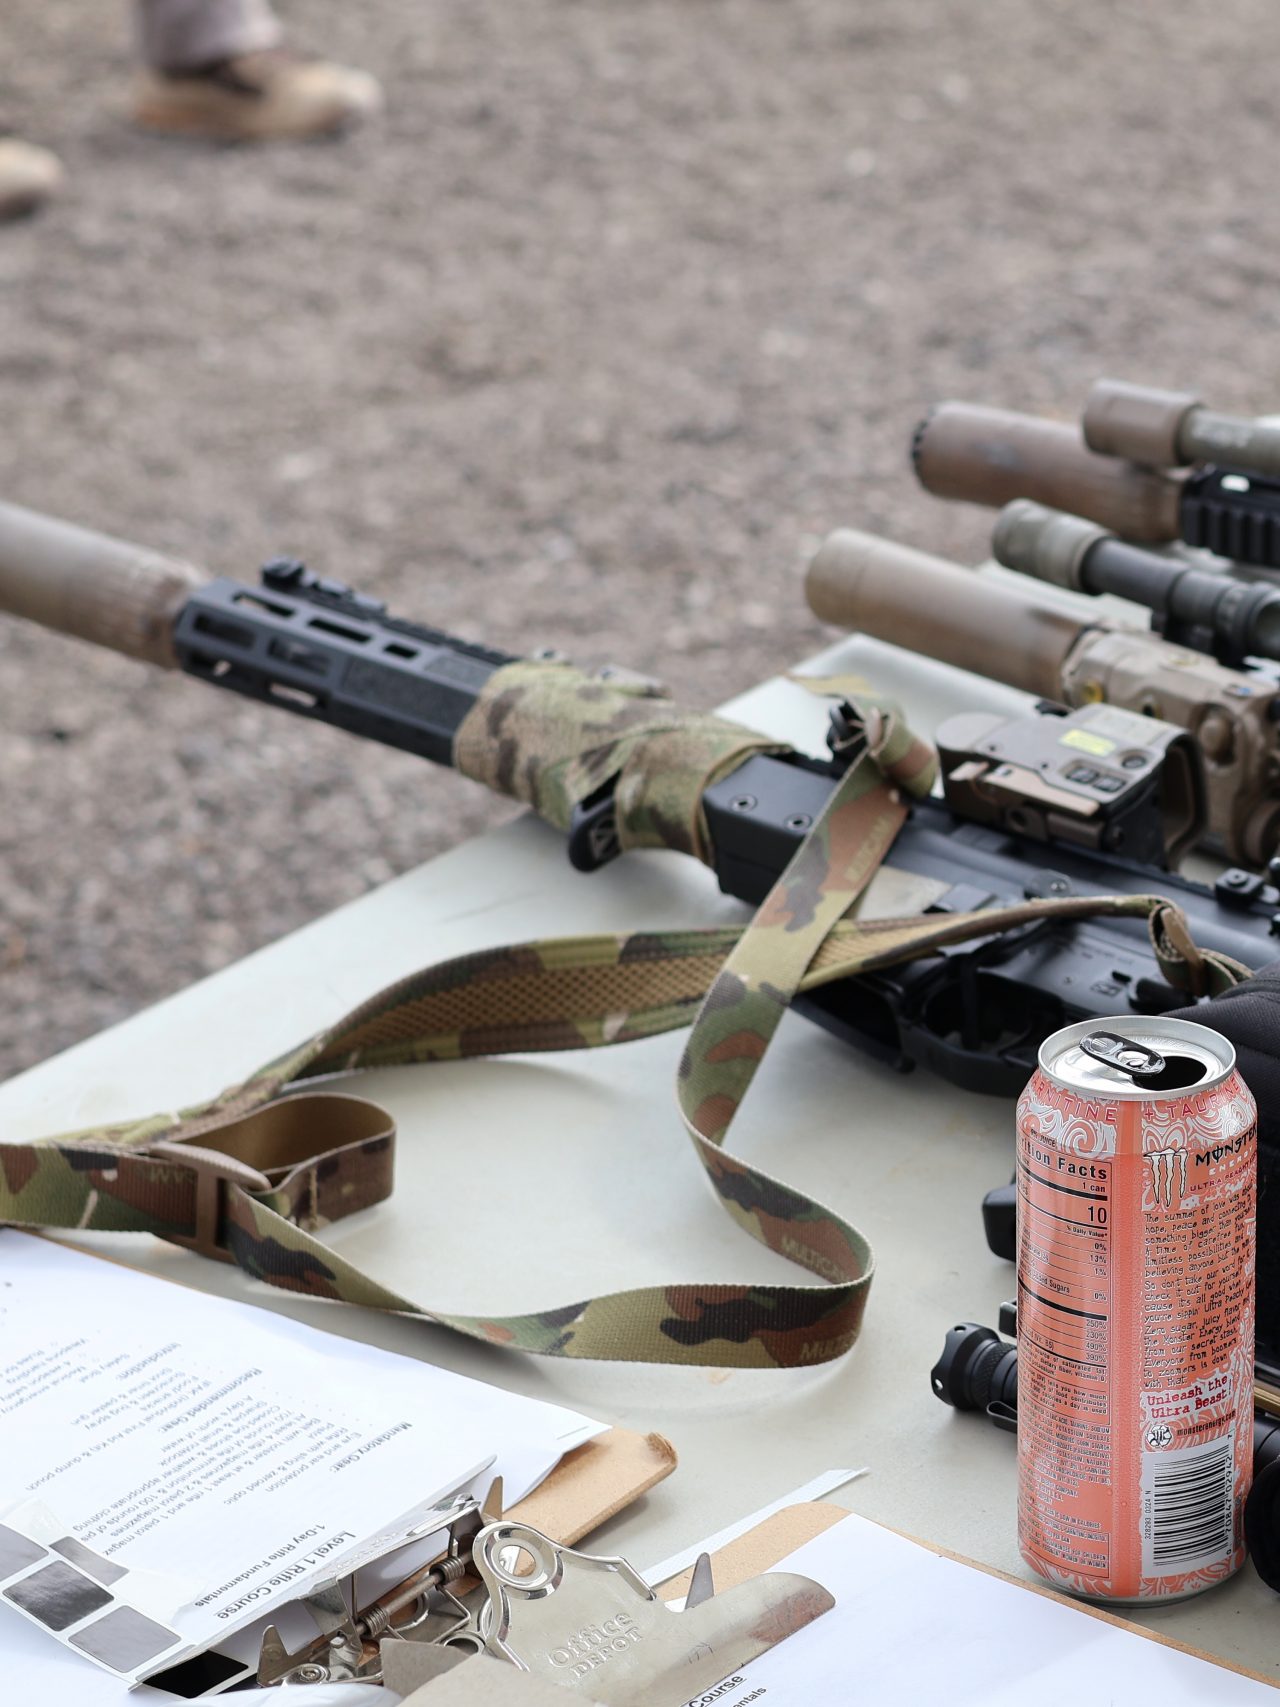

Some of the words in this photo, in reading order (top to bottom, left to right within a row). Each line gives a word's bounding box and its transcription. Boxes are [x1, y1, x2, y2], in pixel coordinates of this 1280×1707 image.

[1167, 1078, 1240, 1119] TAURINE
[1022, 1134, 1050, 1166] rition
[1058, 1156, 1106, 1179] Facts
[1090, 1184, 1105, 1192] can
[1189, 1176, 1220, 1192] ULTRA
[1087, 1205, 1107, 1223] 10
[1145, 1213, 1158, 1222] The
[1164, 1209, 1197, 1221] summer
[1212, 1199, 1225, 1211] love
[1072, 1226, 1086, 1236] Daily
[1144, 1224, 1166, 1234] hope,
[1172, 1220, 1197, 1231] peace
[1201, 1213, 1214, 1225] and
[1144, 1232, 1186, 1245] something
[1191, 1224, 1214, 1240] bigger
[1219, 1217, 1231, 1230] than
[1094, 1242, 1106, 1251] 0%
[1144, 1254, 1182, 1266] limitless
[1188, 1238, 1231, 1261] possibilities
[1235, 1230, 1243, 1243] and
[1155, 1244, 1176, 1254] time
[1183, 1241, 1192, 1251] of
[1198, 1228, 1231, 1248] carefree
[780, 1236, 850, 1284] MULTICA
[1090, 1254, 1106, 1263] 13%
[1144, 1264, 1183, 1277] believing
[1188, 1258, 1214, 1272] anyone
[1095, 1267, 1106, 1276] 1%
[1144, 1280, 1156, 1290] So
[1185, 1273, 1201, 1285] take
[1206, 1269, 1217, 1280] our
[1222, 1261, 1234, 1273] word
[1049, 1279, 1069, 1294] Sugars
[1094, 1291, 1106, 1300] 0%
[1144, 1291, 1171, 1301] check
[1175, 1289, 1184, 1297] it
[1186, 1286, 1200, 1295] out
[1204, 1279, 1214, 1291] for
[1144, 1302, 1173, 1312] cause
[1196, 1293, 1205, 1304] all
[1210, 1286, 1225, 1301] good
[1204, 1298, 1222, 1313] Ultra
[1225, 1285, 1244, 1304] Peachy
[1143, 1337, 1157, 1345] the
[1163, 1331, 1195, 1345] Monster
[1199, 1322, 1222, 1338] Energy
[1226, 1311, 1240, 1327] blend
[1144, 1324, 1165, 1335] Zero
[1170, 1320, 1197, 1333] sugar,
[1224, 1301, 1240, 1317] flavor
[1086, 1330, 1106, 1340] 230%
[1086, 1341, 1106, 1351] 490%
[1144, 1347, 1165, 1356] from
[1171, 1345, 1186, 1354] our
[1191, 1336, 1215, 1350] secret
[1144, 1355, 1184, 1368] Everyone
[1189, 1348, 1206, 1361] from
[1211, 1336, 1236, 1355] boomers
[1058, 1365, 1072, 1375] fiber,
[1062, 1359, 1090, 1372] saturated
[1143, 1370, 1153, 1378] to
[1159, 1363, 1196, 1376] zoomers
[1212, 1351, 1226, 1364] down
[1060, 1384, 1070, 1393] you
[1073, 1388, 1085, 1396] how
[1089, 1392, 1106, 1400] much
[1144, 1379, 1162, 1388] with
[1147, 1384, 1202, 1406] Unleash
[1208, 1373, 1227, 1391] the
[1056, 1390, 1067, 1399] food
[1070, 1395, 1106, 1407] contributes
[1069, 1401, 1079, 1409] day
[1150, 1403, 1190, 1418] Ultra
[1194, 1378, 1231, 1410] Beast!
[1176, 1408, 1235, 1436] monsterenergy.com
[280, 1428, 305, 1442] with
[323, 1426, 349, 1441] Rifle
[355, 1421, 413, 1456] Mandatory
[1056, 1424, 1083, 1438] POTASSIUM
[1086, 1433, 1109, 1442] SORBATE
[1076, 1439, 1089, 1447] CORN
[322, 1442, 344, 1455] and
[136, 1493, 159, 1506] 100
[155, 1487, 169, 1495] &
[183, 1490, 207, 1503] rifle
[165, 1501, 189, 1515] and
[106, 1504, 162, 1537] magazines
[289, 1522, 328, 1544] 1-Day
[265, 1542, 298, 1561] Rifle
[311, 1531, 357, 1558] Level
[301, 1556, 319, 1564] 1
[192, 1559, 272, 1608] Fundamentals
[266, 1563, 308, 1587] Rifle
[214, 1585, 274, 1620] Course
[548, 1612, 633, 1668] Office
[570, 1626, 643, 1679] DEPOT
